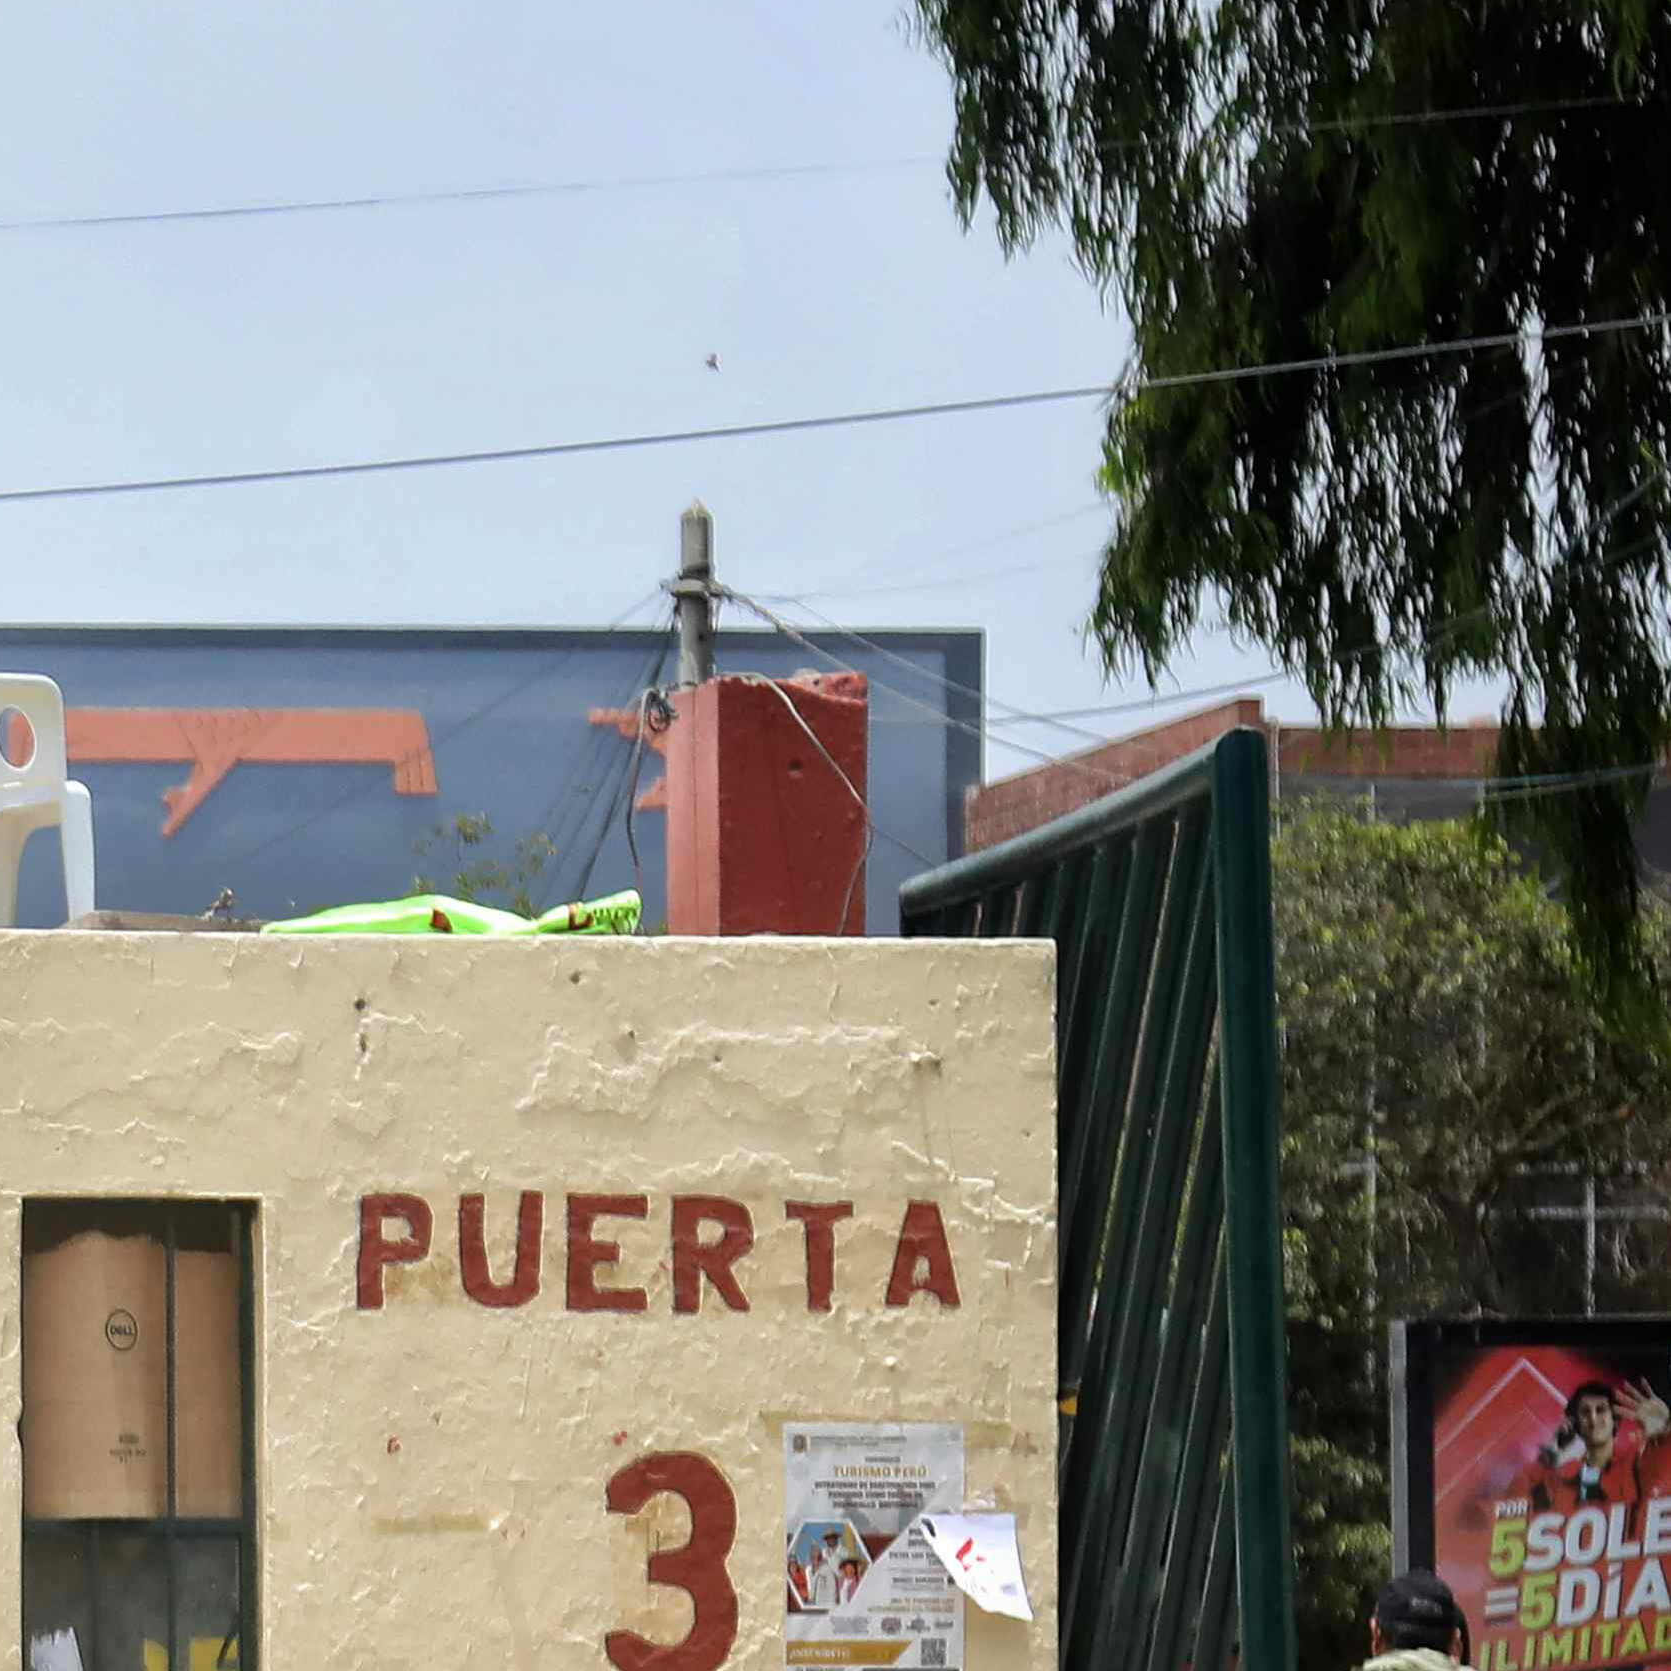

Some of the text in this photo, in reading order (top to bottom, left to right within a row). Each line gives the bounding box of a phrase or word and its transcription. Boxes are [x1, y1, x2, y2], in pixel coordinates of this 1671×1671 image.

[357, 1189, 962, 1314] PUERTA
[834, 1465, 891, 1477] TURISMO
[1495, 1501, 1527, 1516] POR
